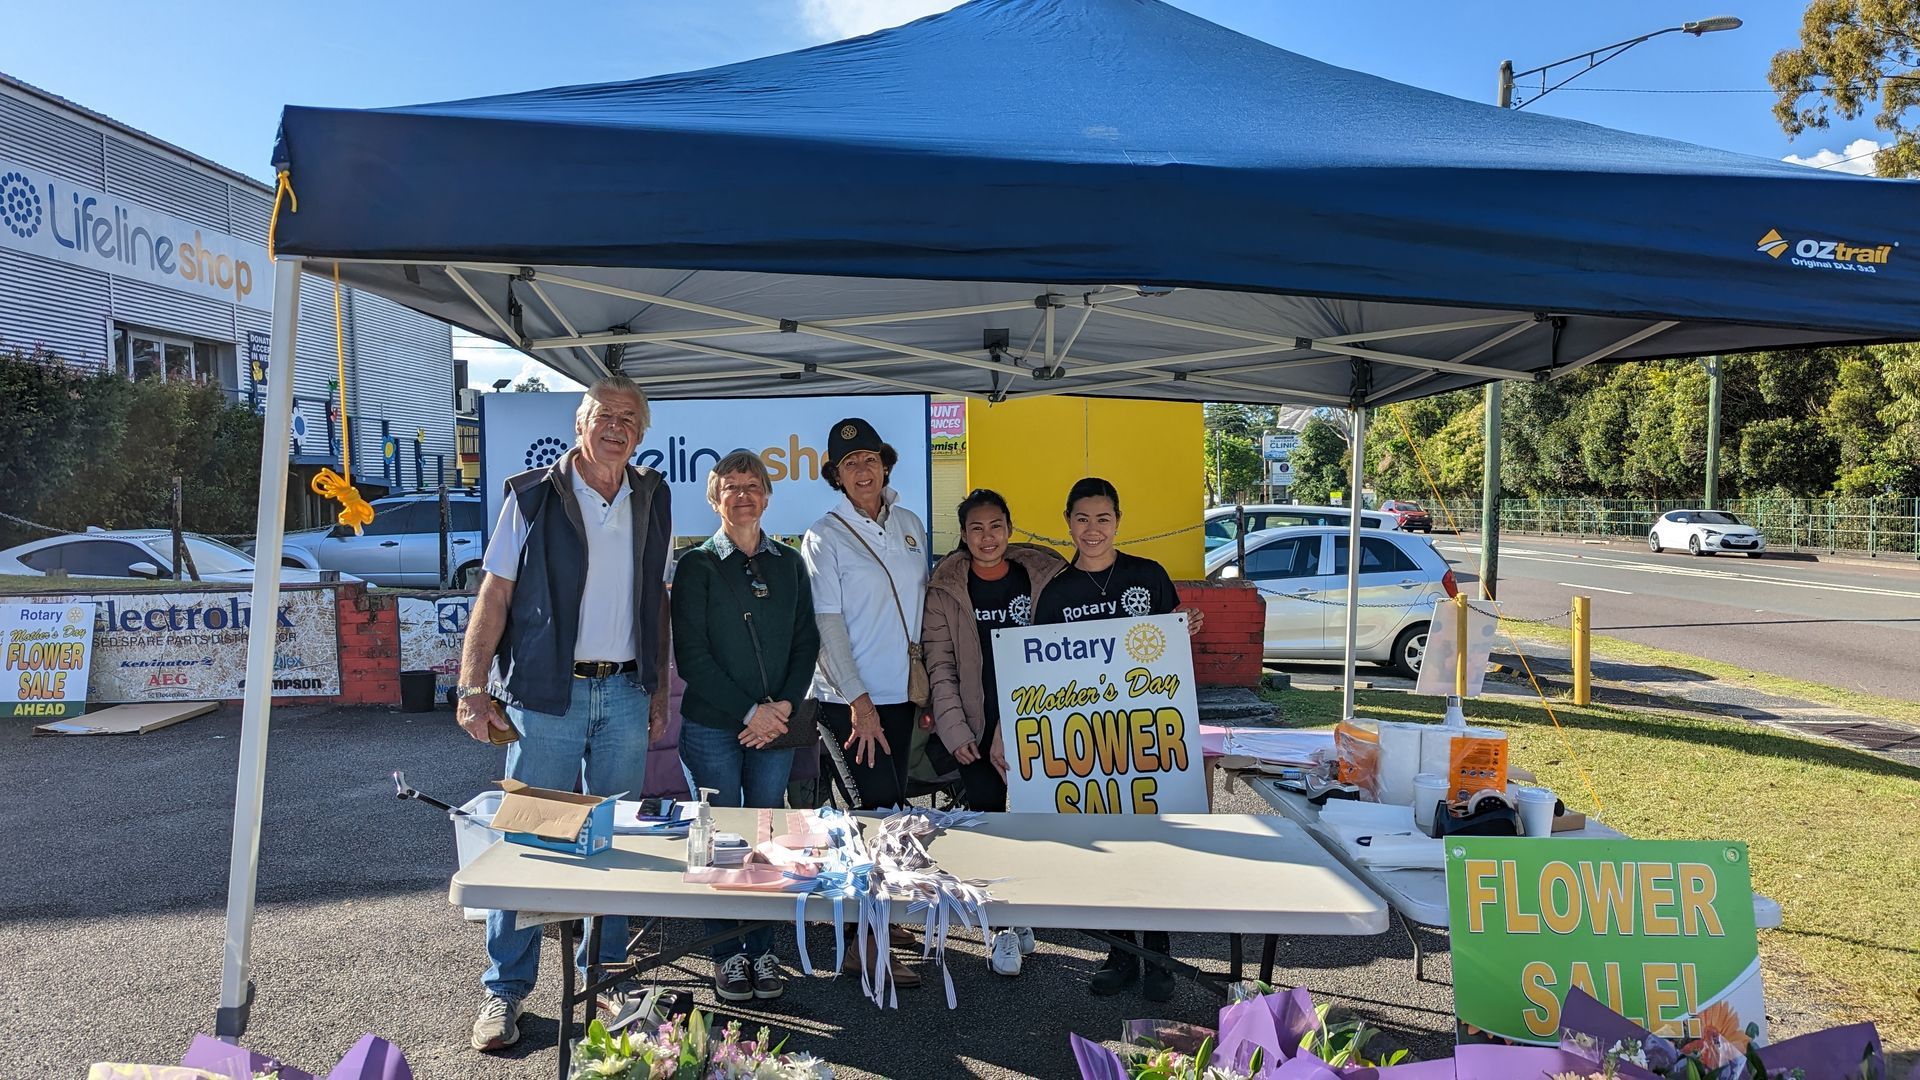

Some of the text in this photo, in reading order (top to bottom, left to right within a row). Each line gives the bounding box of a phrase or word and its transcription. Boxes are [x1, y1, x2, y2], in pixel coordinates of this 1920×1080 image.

[48, 183, 253, 302] Lifeline shop
[1795, 239, 1892, 264] OZtrail
[1791, 257, 1877, 273] Original DLX 3x3
[250, 334, 271, 345] DONAT
[930, 418, 961, 429] ANCES
[760, 434, 829, 481] sh
[20, 609, 63, 623] Rotary
[974, 608, 1007, 623] tary
[1062, 600, 1117, 623] Rotary
[10, 625, 86, 642] Mother's Day
[121, 636, 164, 647] SPARE
[166, 634, 209, 646] PARTS
[6, 642, 85, 671] FLOWER
[1023, 636, 1116, 664] Rotary
[120, 659, 199, 668] Kelvinator
[18, 671, 67, 700] SALE
[148, 673, 188, 686] AEG
[1011, 667, 1180, 716] Mother's Day
[14, 703, 66, 716] AHEAD
[1015, 707, 1189, 781] FLOWER
[576, 817, 593, 855] Larg
[1464, 859, 1725, 937] FLOWER
